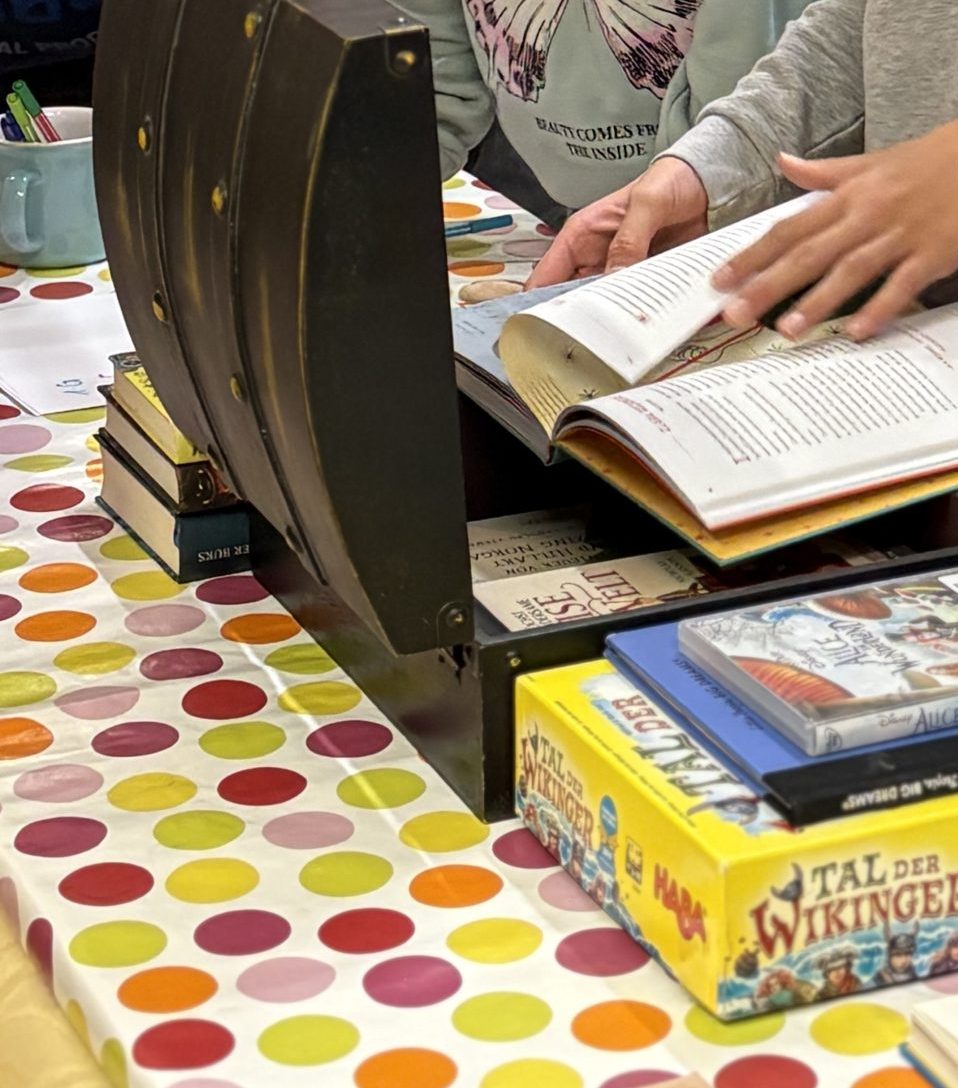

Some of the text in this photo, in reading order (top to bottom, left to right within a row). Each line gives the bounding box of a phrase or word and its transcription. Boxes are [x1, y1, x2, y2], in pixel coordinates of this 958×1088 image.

[566, 142, 646, 160] THE INSIDE
[577, 125, 634, 142] COMES
[812, 634, 874, 668] ALICE
[612, 695, 672, 733] DER
[540, 736, 565, 779] TAL
[521, 737, 594, 850] WIKINGER
[901, 783, 922, 797] BIG
[812, 852, 941, 900] TAL DER
